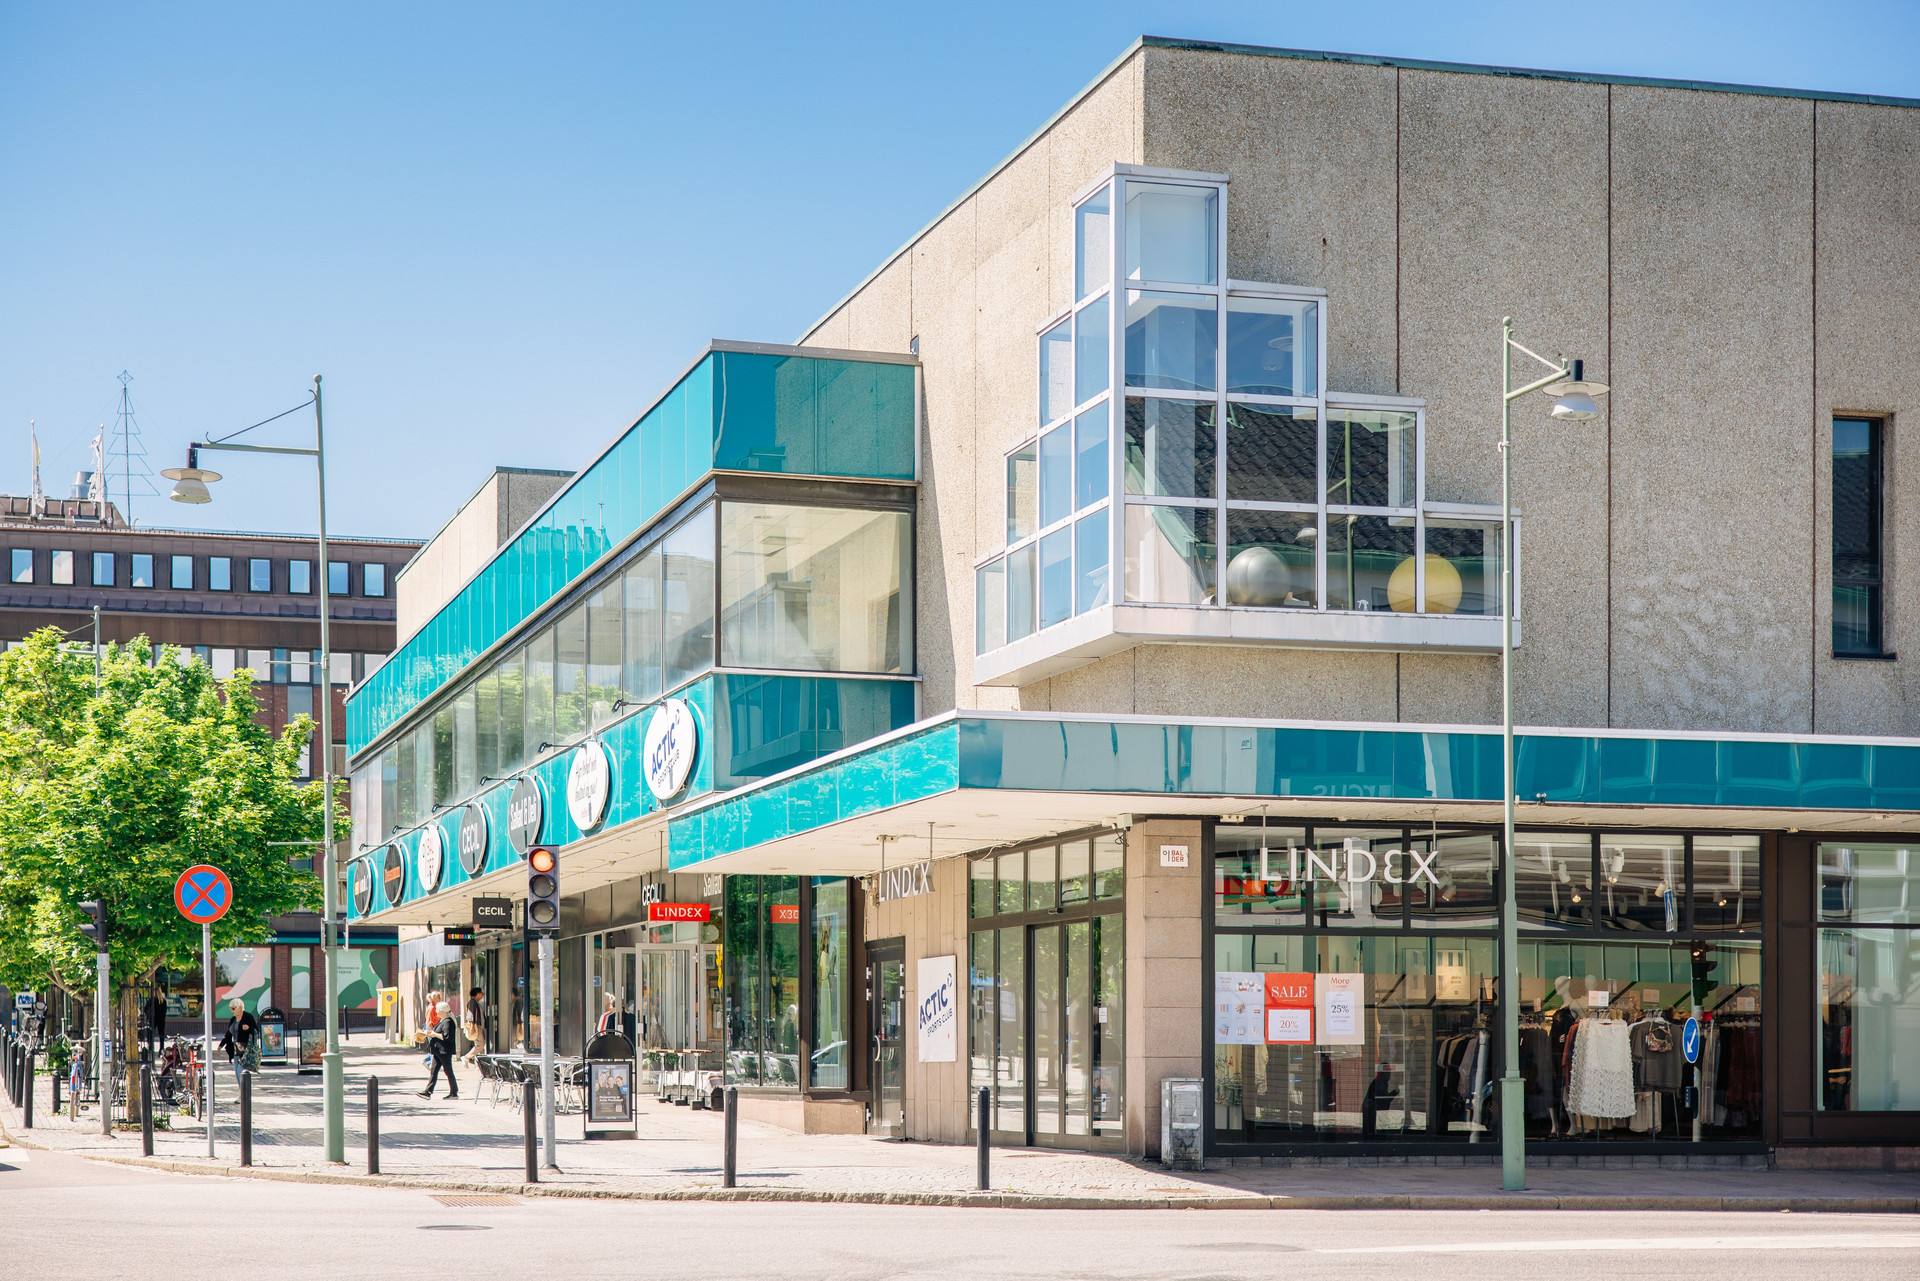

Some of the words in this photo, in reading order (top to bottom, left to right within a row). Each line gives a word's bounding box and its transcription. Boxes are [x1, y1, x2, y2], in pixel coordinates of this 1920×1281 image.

[651, 722, 676, 781] ACTIC
[462, 822, 480, 854] CECIL
[1260, 847, 1440, 884] LINDEX
[642, 883, 661, 906] CECIL
[878, 861, 932, 902] LINDEX
[478, 906, 506, 916] CECIL
[657, 907, 702, 918] LINDEX
[1271, 985, 1308, 998] SALE
[919, 983, 948, 1029] ACTIC
[1331, 1004, 1350, 1013] 25%
[927, 1017, 942, 1037] SPORTS
[941, 1008, 953, 1024] CLUB
[1280, 1020, 1299, 1028] 20%
